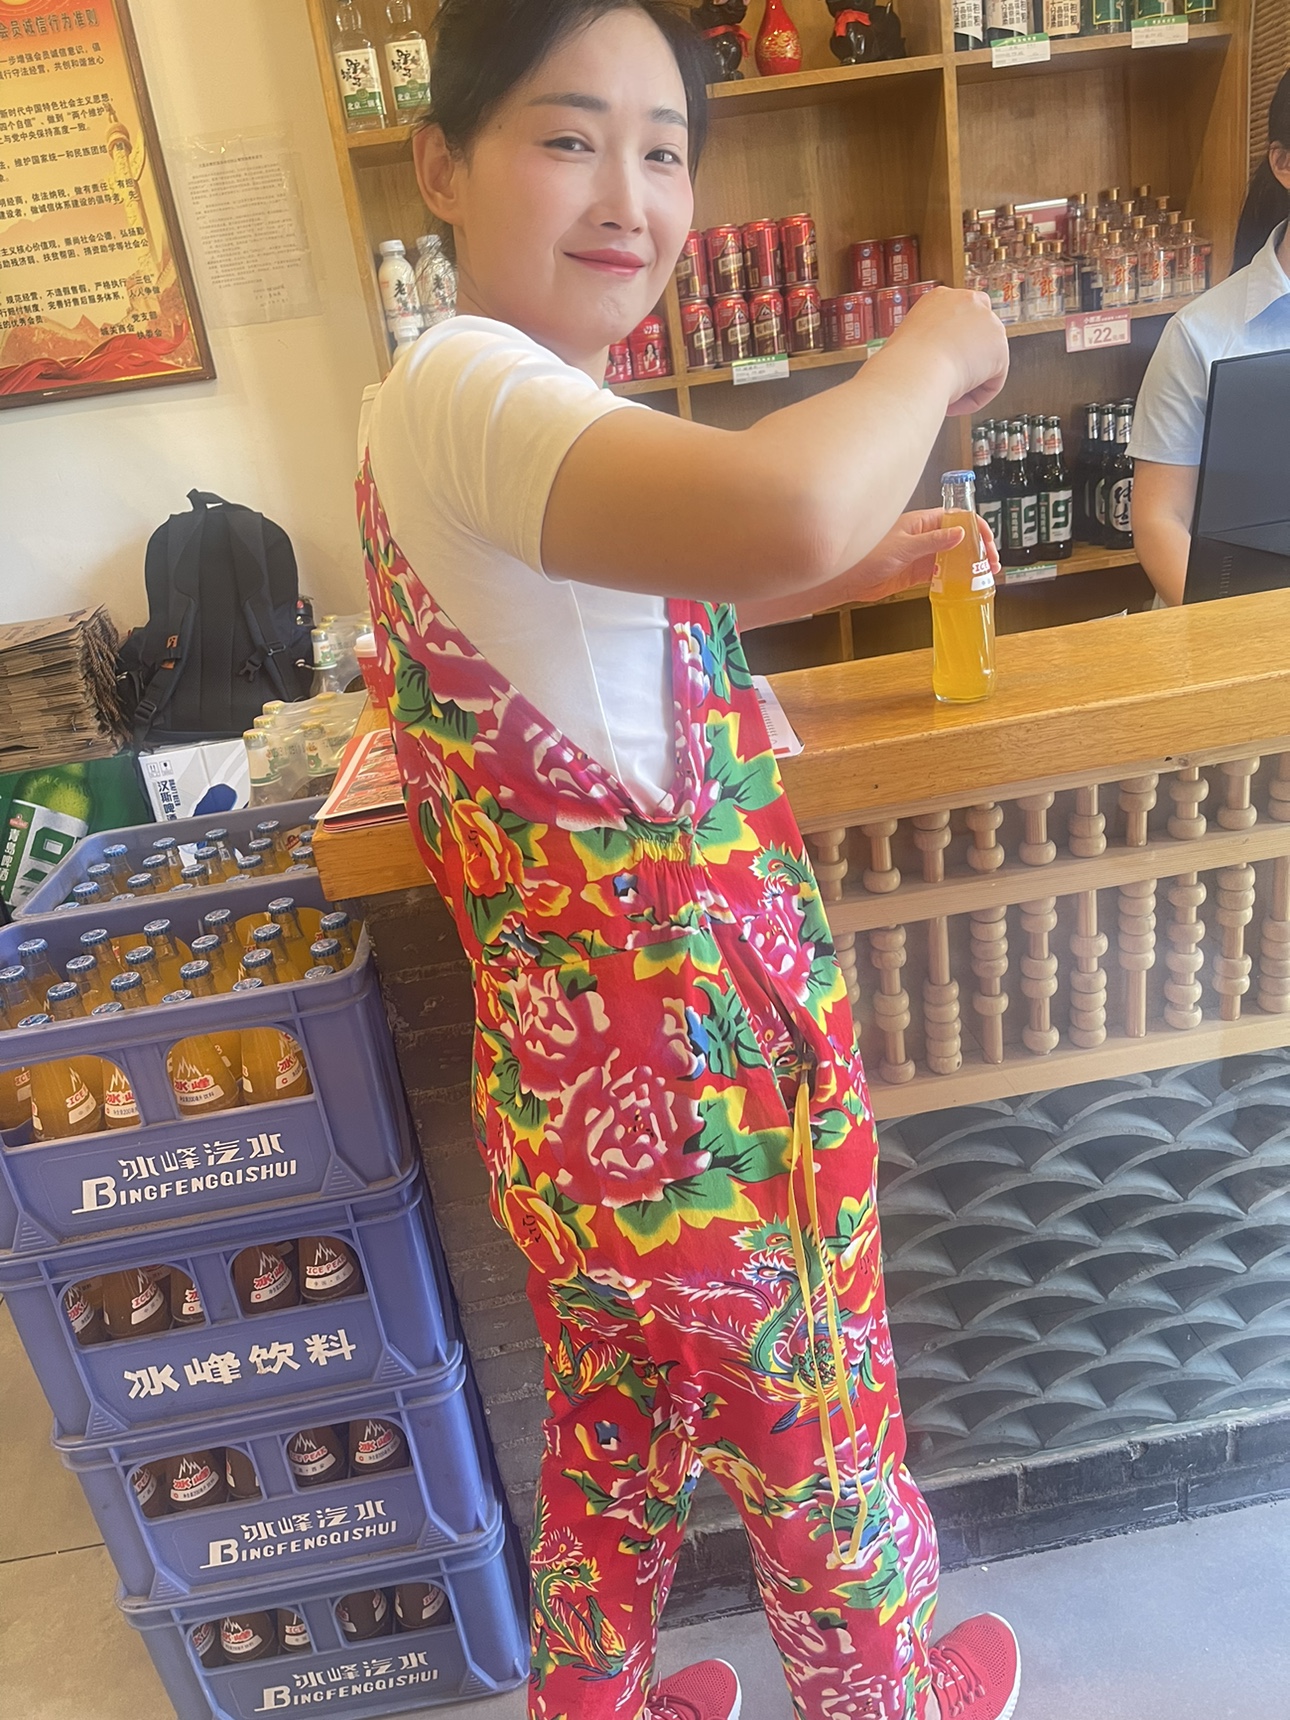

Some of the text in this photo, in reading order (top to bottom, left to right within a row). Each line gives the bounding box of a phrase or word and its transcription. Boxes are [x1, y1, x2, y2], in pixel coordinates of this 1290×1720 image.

[118, 1133, 285, 1182] 冰峰汽水
[72, 1160, 297, 1214] BINGFENGQISHUI
[124, 1329, 356, 1400] 冰峰饮料
[200, 1520, 397, 1569] BINGFENGQISHUI
[241, 1500, 388, 1542] 冰峰汽水
[254, 1669, 439, 1712] BINGFENGQISHUI
[292, 1651, 429, 1689] 冰峰汽水
